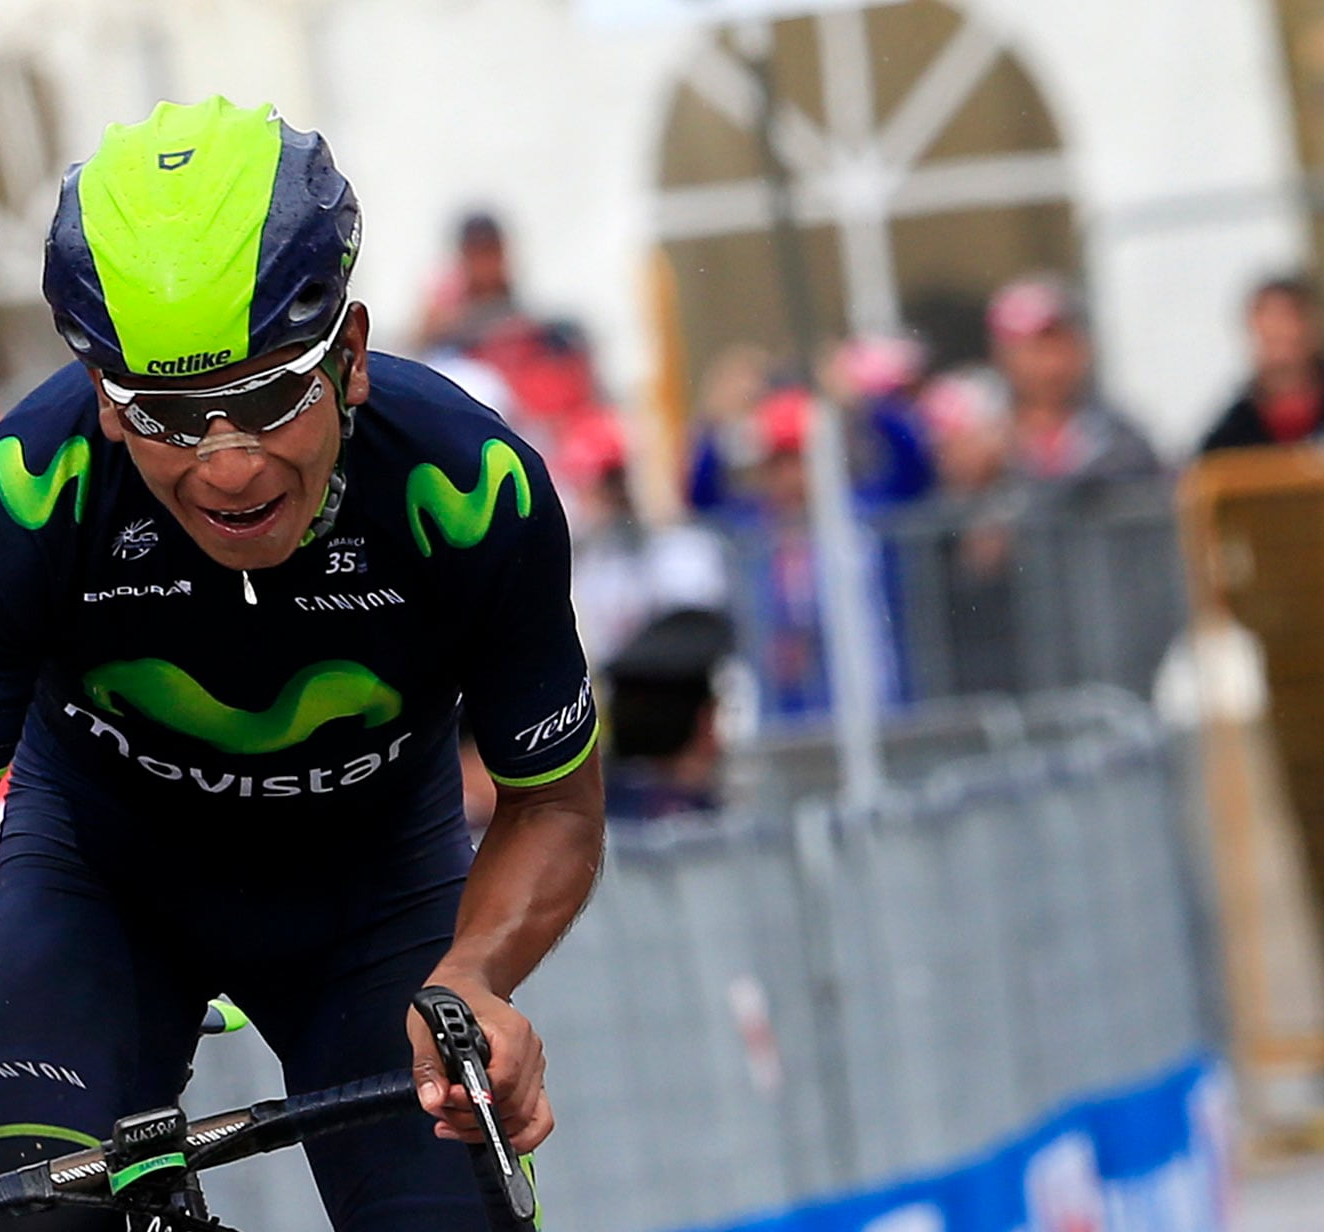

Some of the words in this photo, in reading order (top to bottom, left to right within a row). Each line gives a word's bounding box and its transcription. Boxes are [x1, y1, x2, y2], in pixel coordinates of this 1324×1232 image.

[147, 348, 231, 375] catlike
[326, 552, 357, 574] 35
[84, 585, 181, 602] ENDURA
[294, 588, 405, 611] CANYON
[63, 702, 412, 797] movistar
